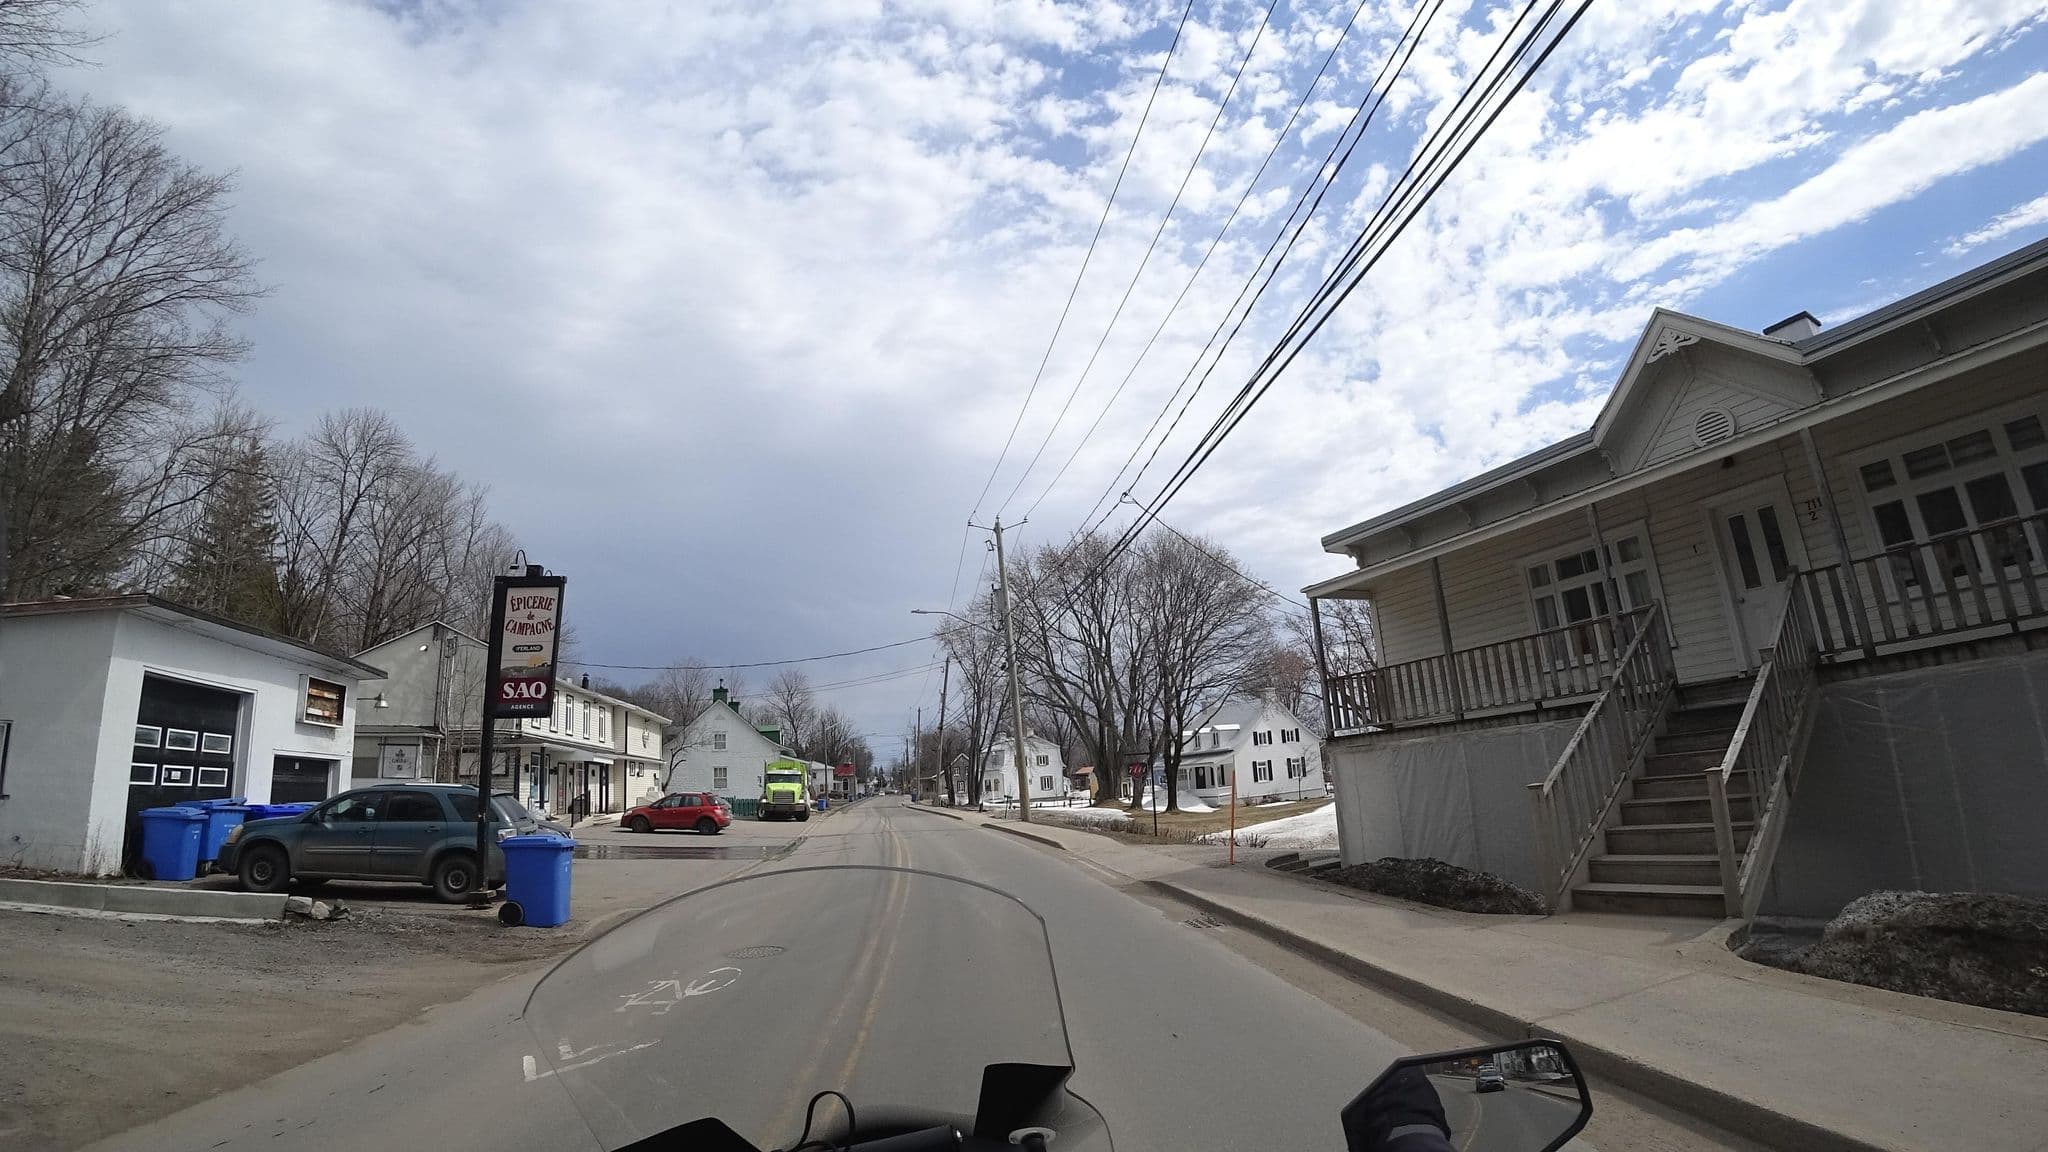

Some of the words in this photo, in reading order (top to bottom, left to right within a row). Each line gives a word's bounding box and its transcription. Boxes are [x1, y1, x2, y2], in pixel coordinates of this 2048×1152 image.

[510, 596, 555, 612] ÉPICERIE
[527, 610, 535, 620] de
[505, 618, 554, 635] CAMPAGNE
[503, 681, 547, 699] SAQ
